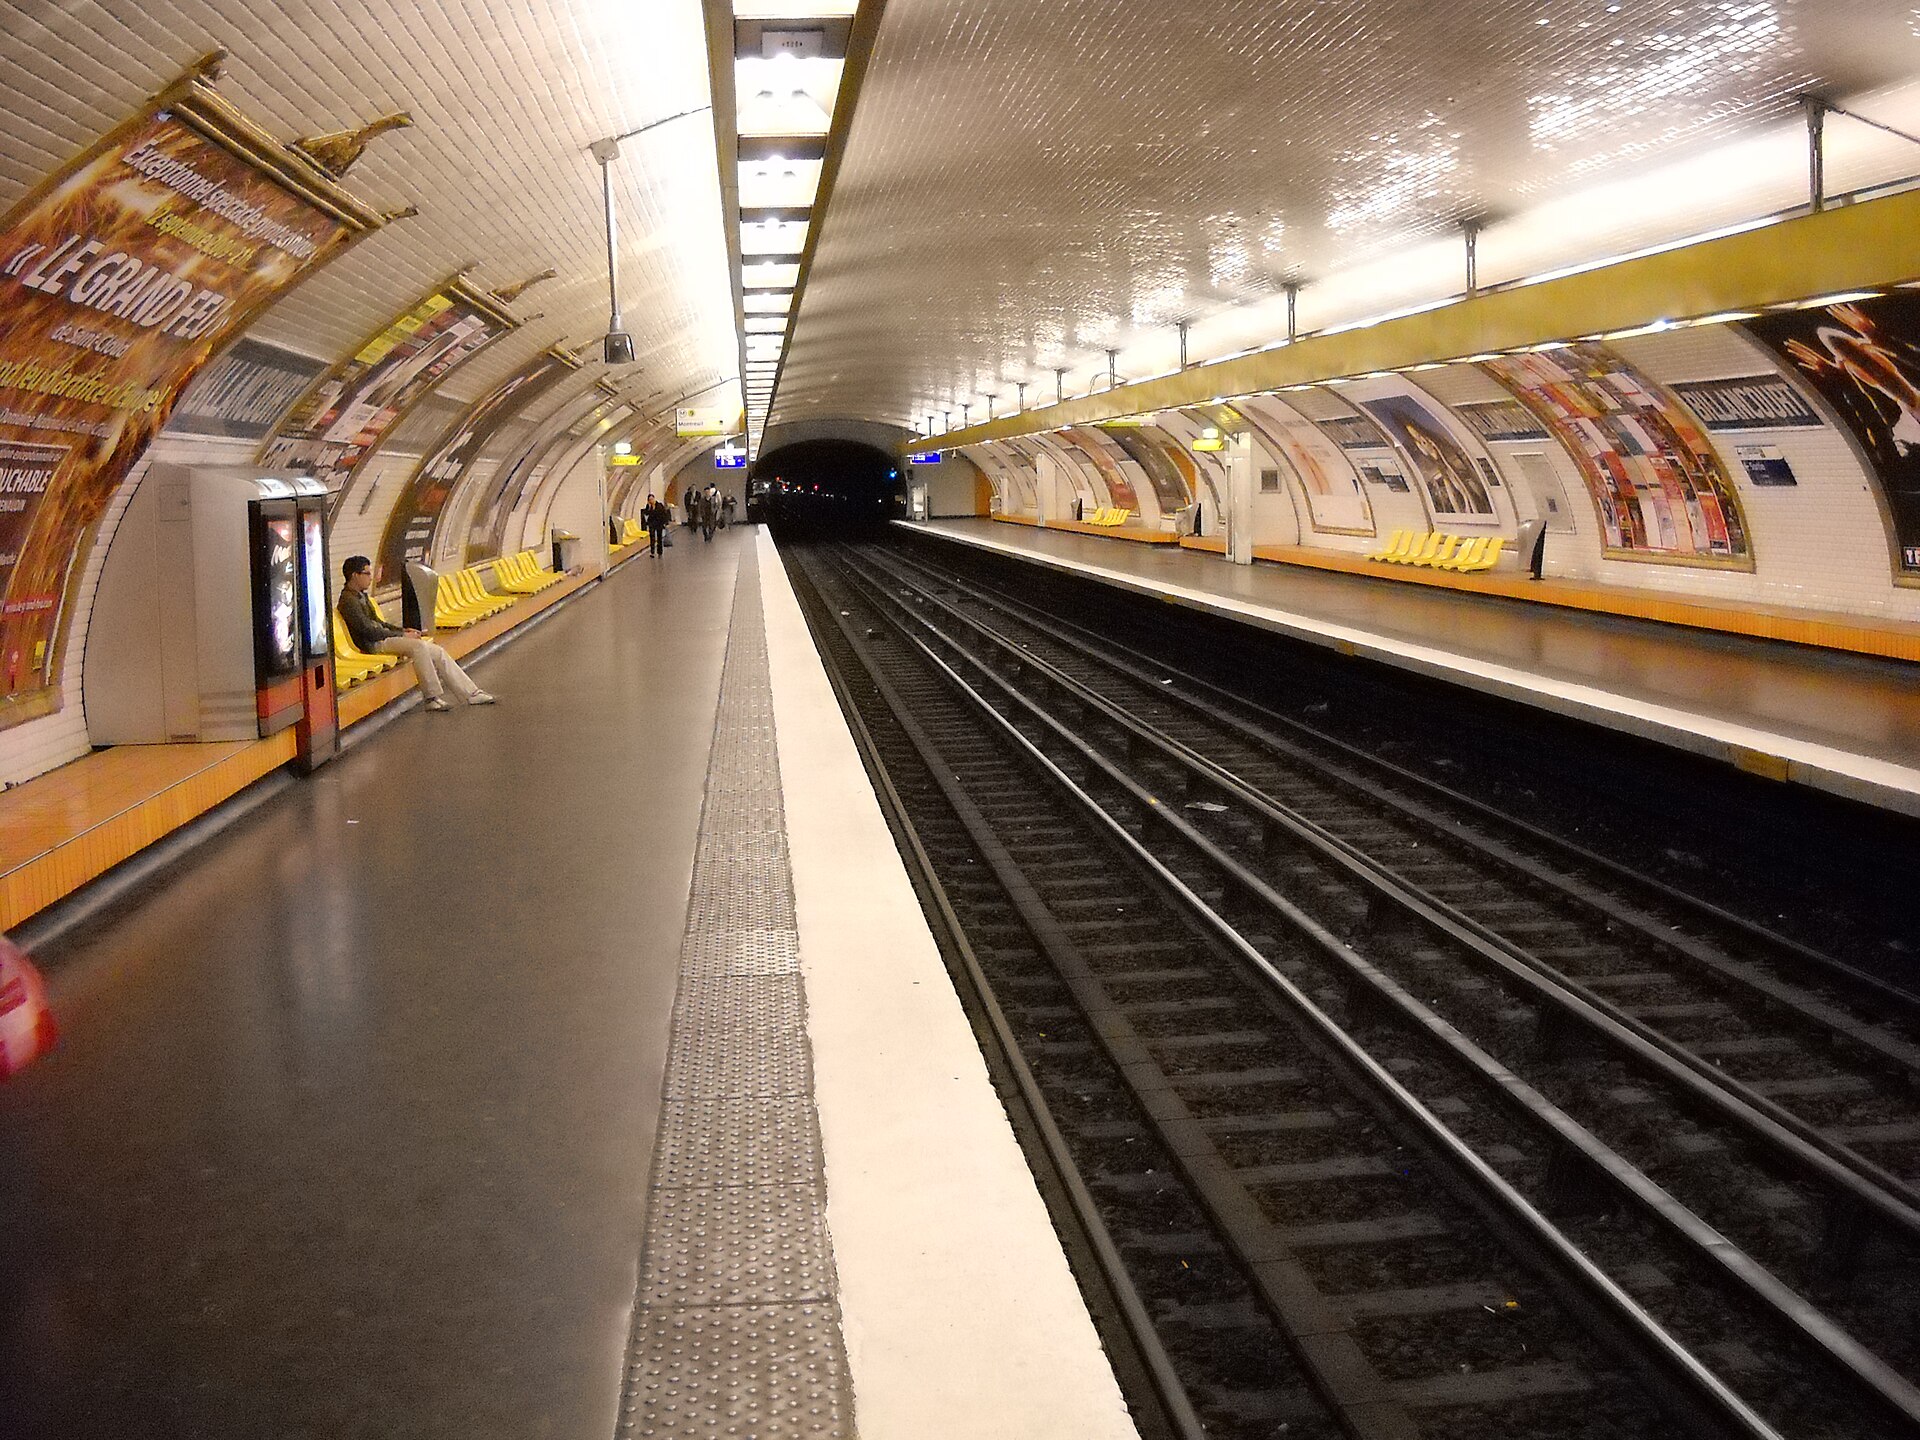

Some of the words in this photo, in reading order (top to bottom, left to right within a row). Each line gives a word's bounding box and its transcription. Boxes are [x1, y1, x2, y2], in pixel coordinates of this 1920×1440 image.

[122, 139, 227, 201] Exceptionnel
[199, 188, 265, 230] spectacle
[155, 212, 213, 250] septembre
[22, 234, 106, 295] LE
[69, 252, 193, 327] GRAND
[162, 289, 237, 340] FEU
[51, 320, 72, 341] de
[65, 327, 134, 359] Saint-Cloud
[18, 357, 47, 390] feu
[39, 361, 110, 402] d'artifice
[181, 356, 312, 424] BILLANCOURT
[1680, 383, 1808, 421] BILLANCOURT
